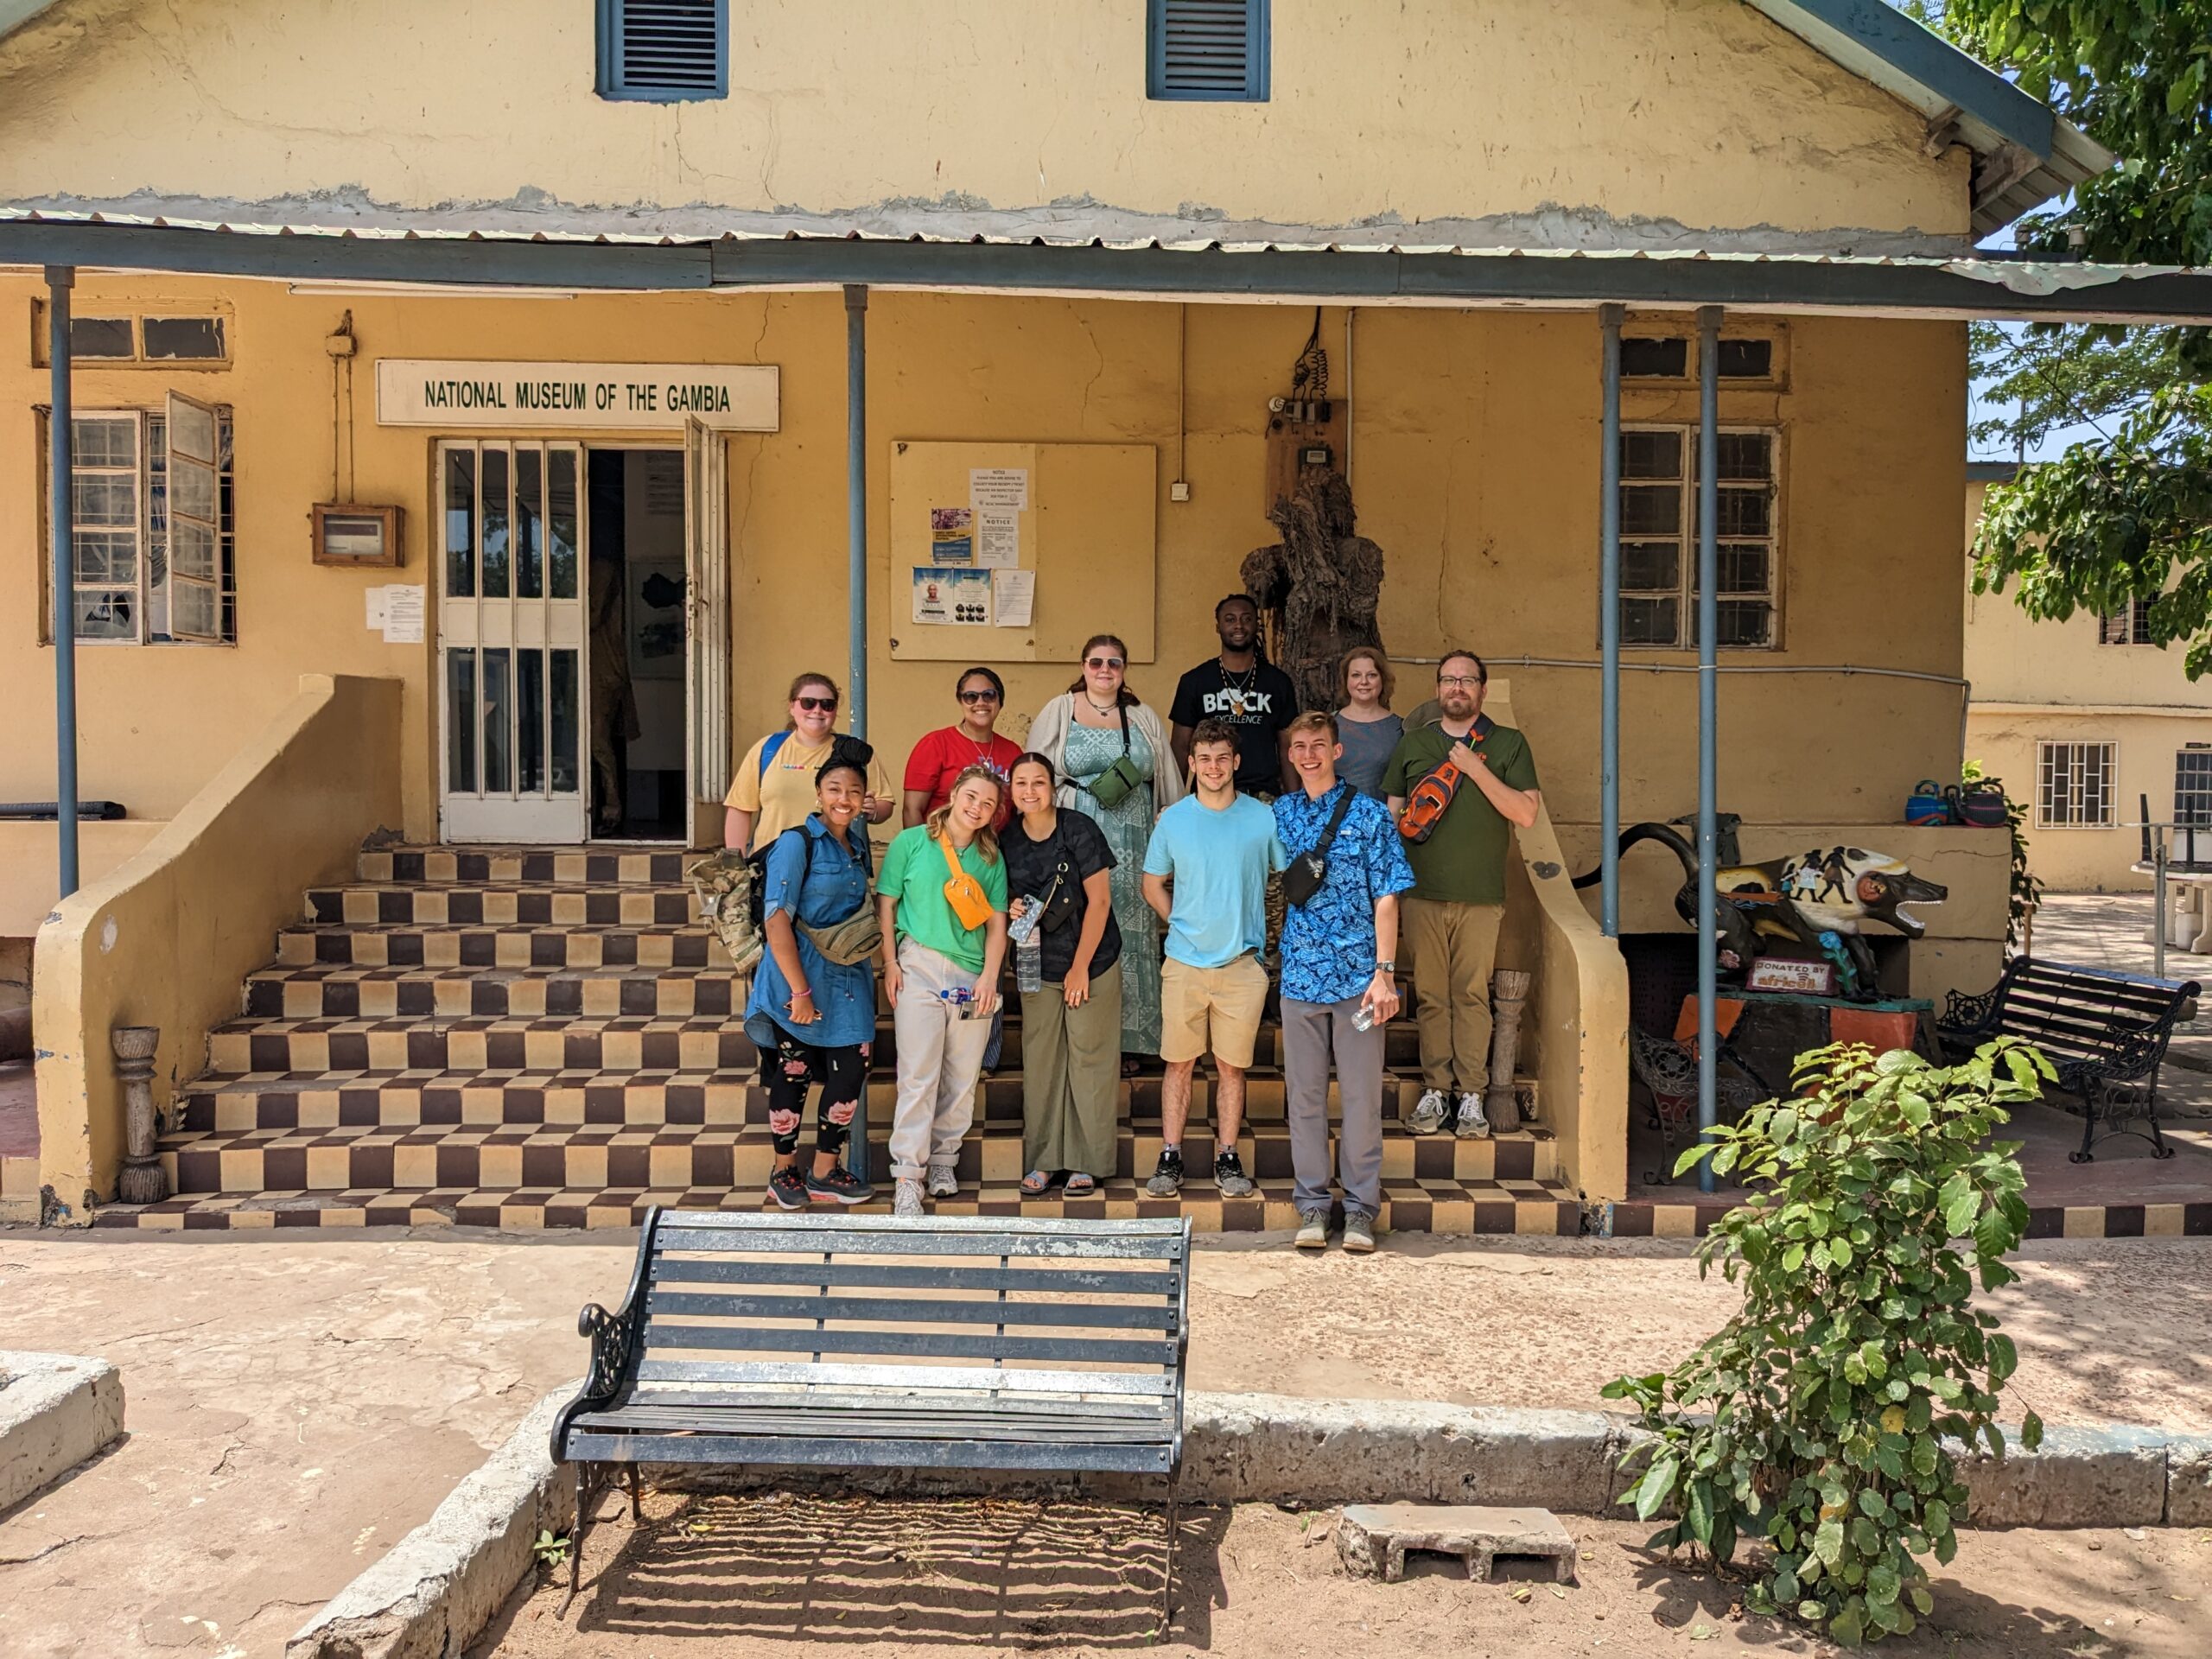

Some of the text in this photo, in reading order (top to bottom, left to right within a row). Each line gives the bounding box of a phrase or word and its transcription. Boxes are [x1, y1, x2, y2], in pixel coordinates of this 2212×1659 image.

[425, 381, 730, 412] NATIONAL MUSEUM OF THE GAMBIA
[1757, 963, 1808, 972] DONATED
